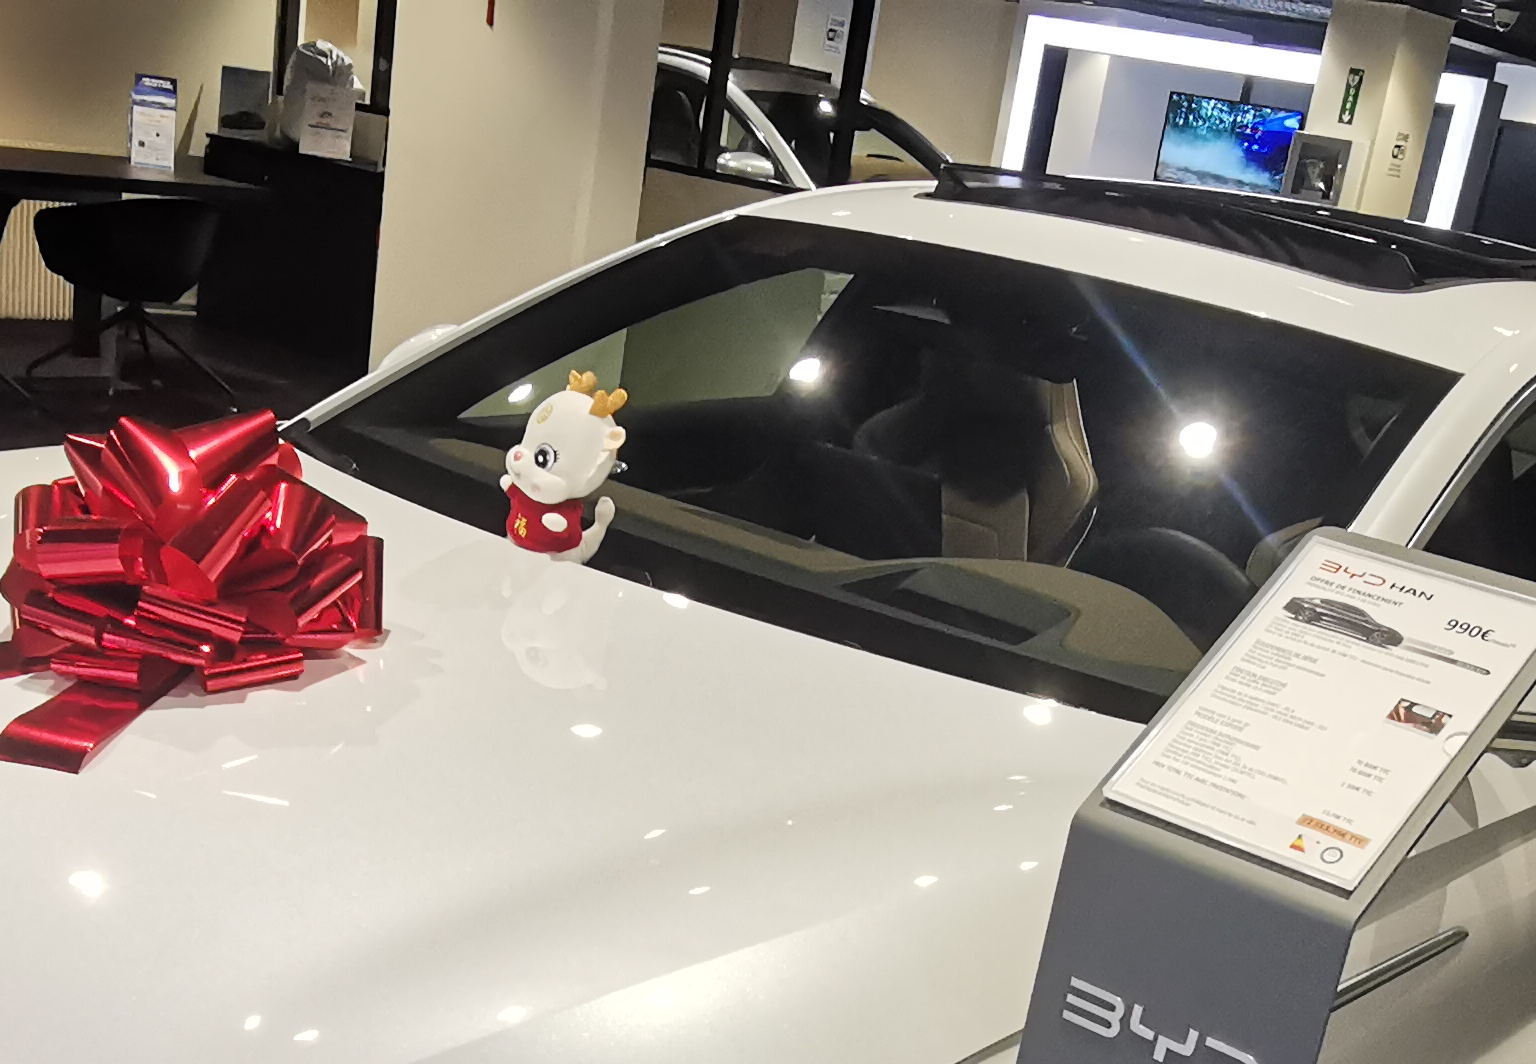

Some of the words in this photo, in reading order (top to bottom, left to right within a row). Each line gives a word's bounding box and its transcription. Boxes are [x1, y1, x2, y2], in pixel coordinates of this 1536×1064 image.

[1318, 559, 1386, 587] BYD
[1389, 582, 1435, 601] HAN
[1444, 618, 1495, 642] 990€
